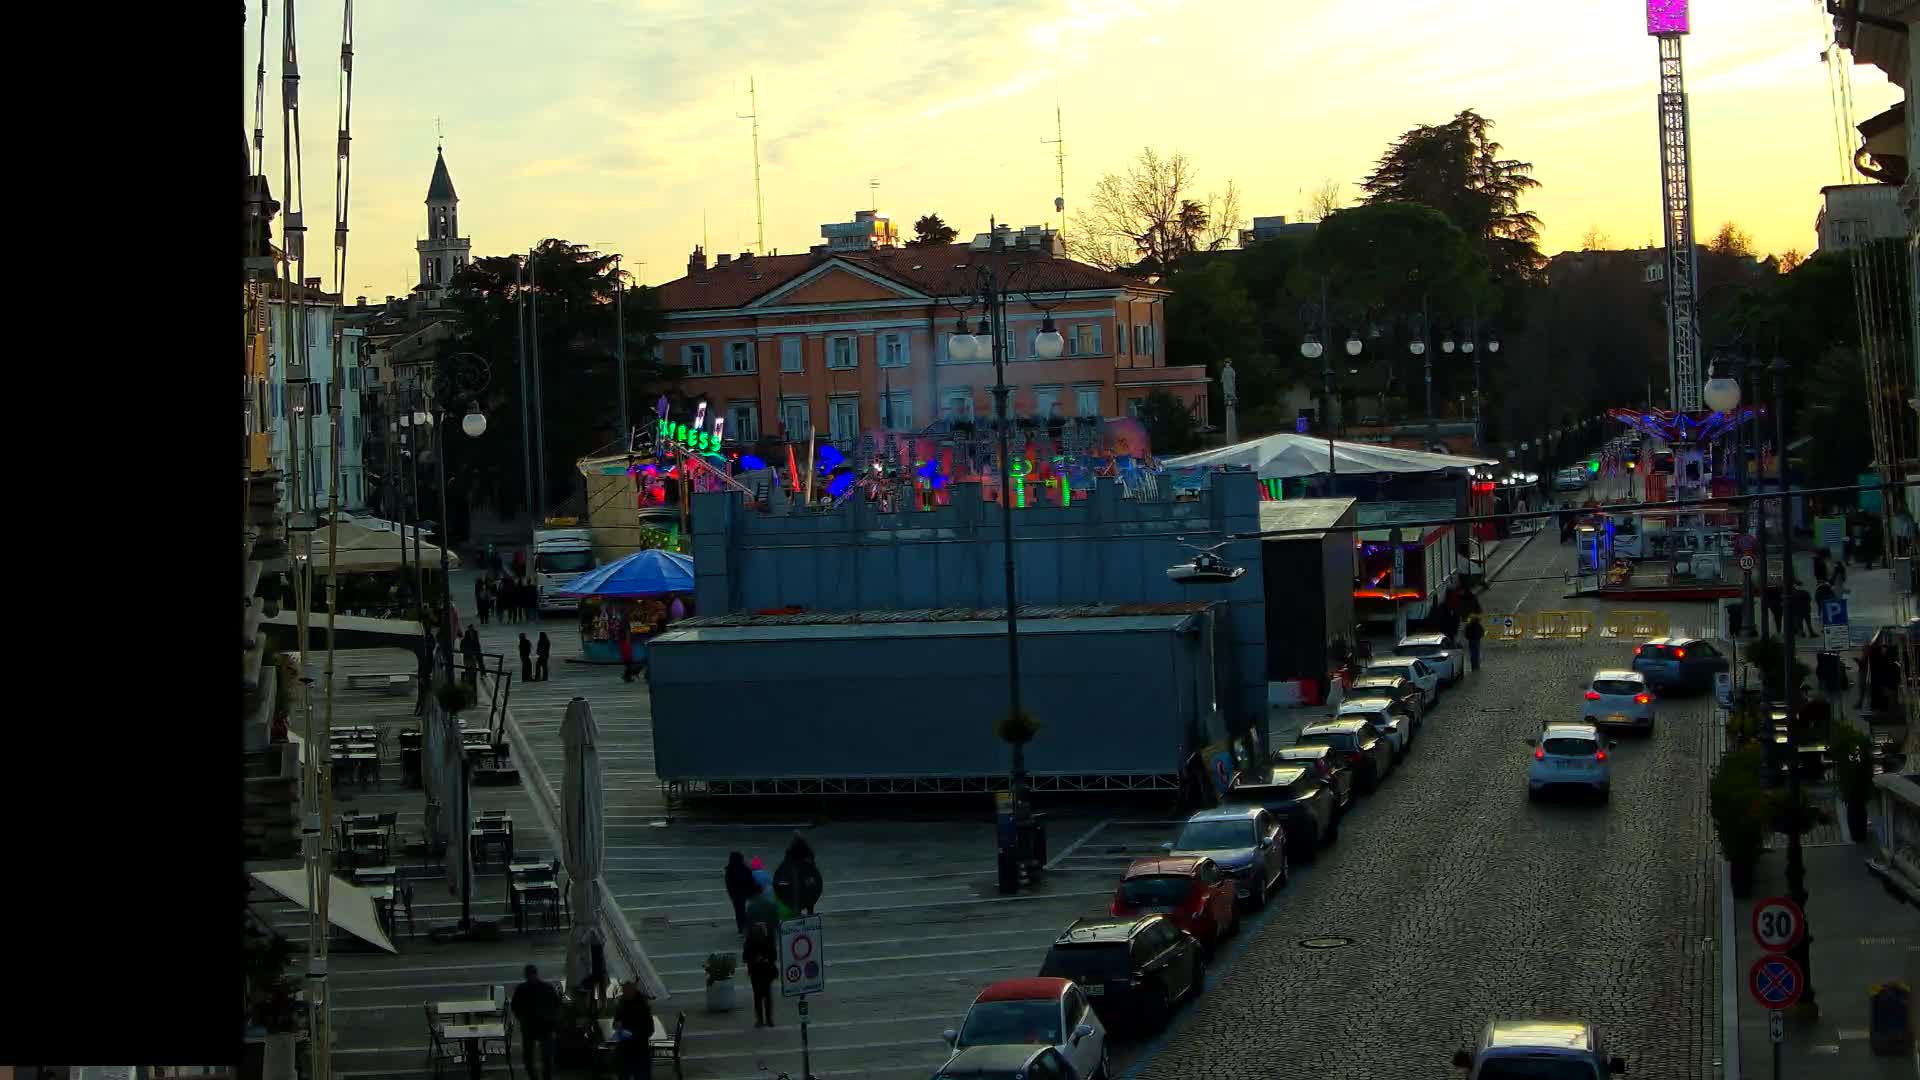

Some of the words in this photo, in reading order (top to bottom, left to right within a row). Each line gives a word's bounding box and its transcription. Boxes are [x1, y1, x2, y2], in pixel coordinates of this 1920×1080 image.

[1741, 557, 1752, 568] 20
[1828, 602, 1841, 622] P
[1762, 911, 1791, 938] 30
